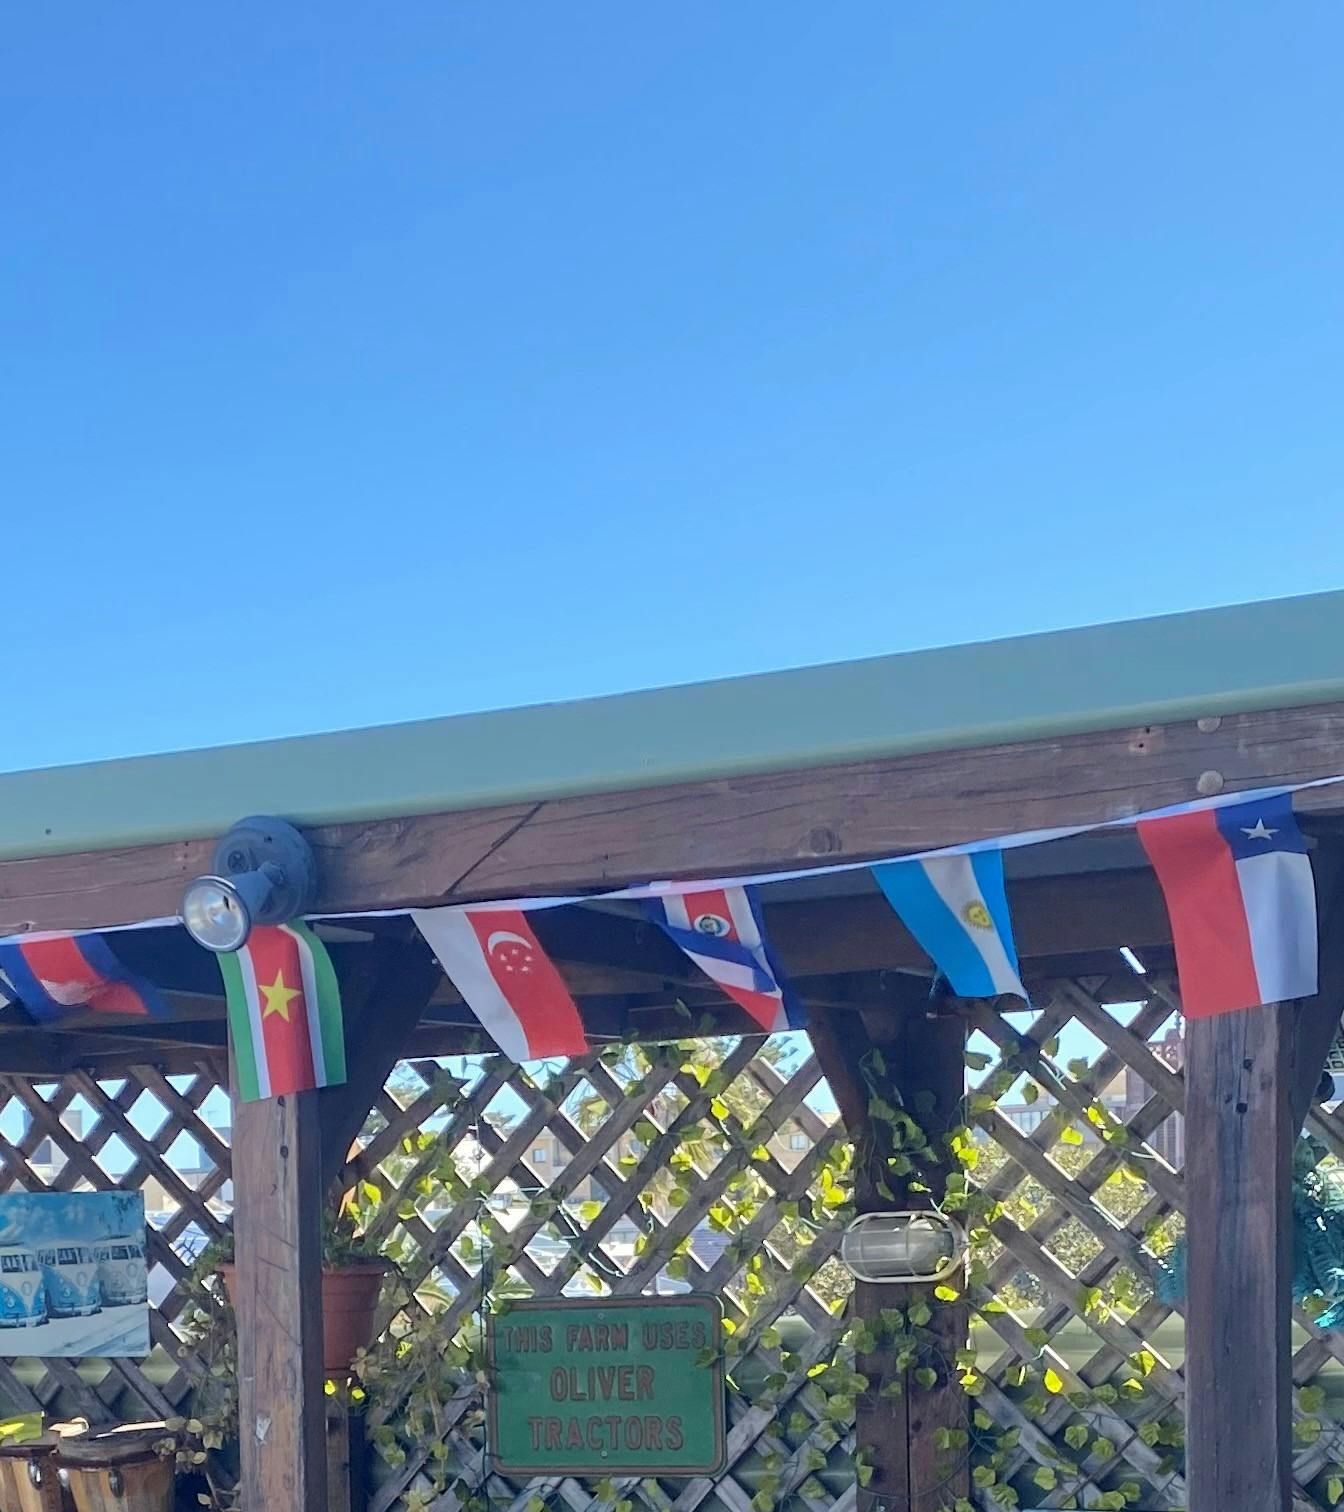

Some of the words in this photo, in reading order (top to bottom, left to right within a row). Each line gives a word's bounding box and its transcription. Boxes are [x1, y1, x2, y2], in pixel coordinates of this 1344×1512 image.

[503, 1325, 553, 1353] THIS
[566, 1322, 629, 1351] FARM
[642, 1321, 706, 1350] USES
[549, 1365, 656, 1402] OLIVER
[528, 1415, 684, 1451] TRACTORS
